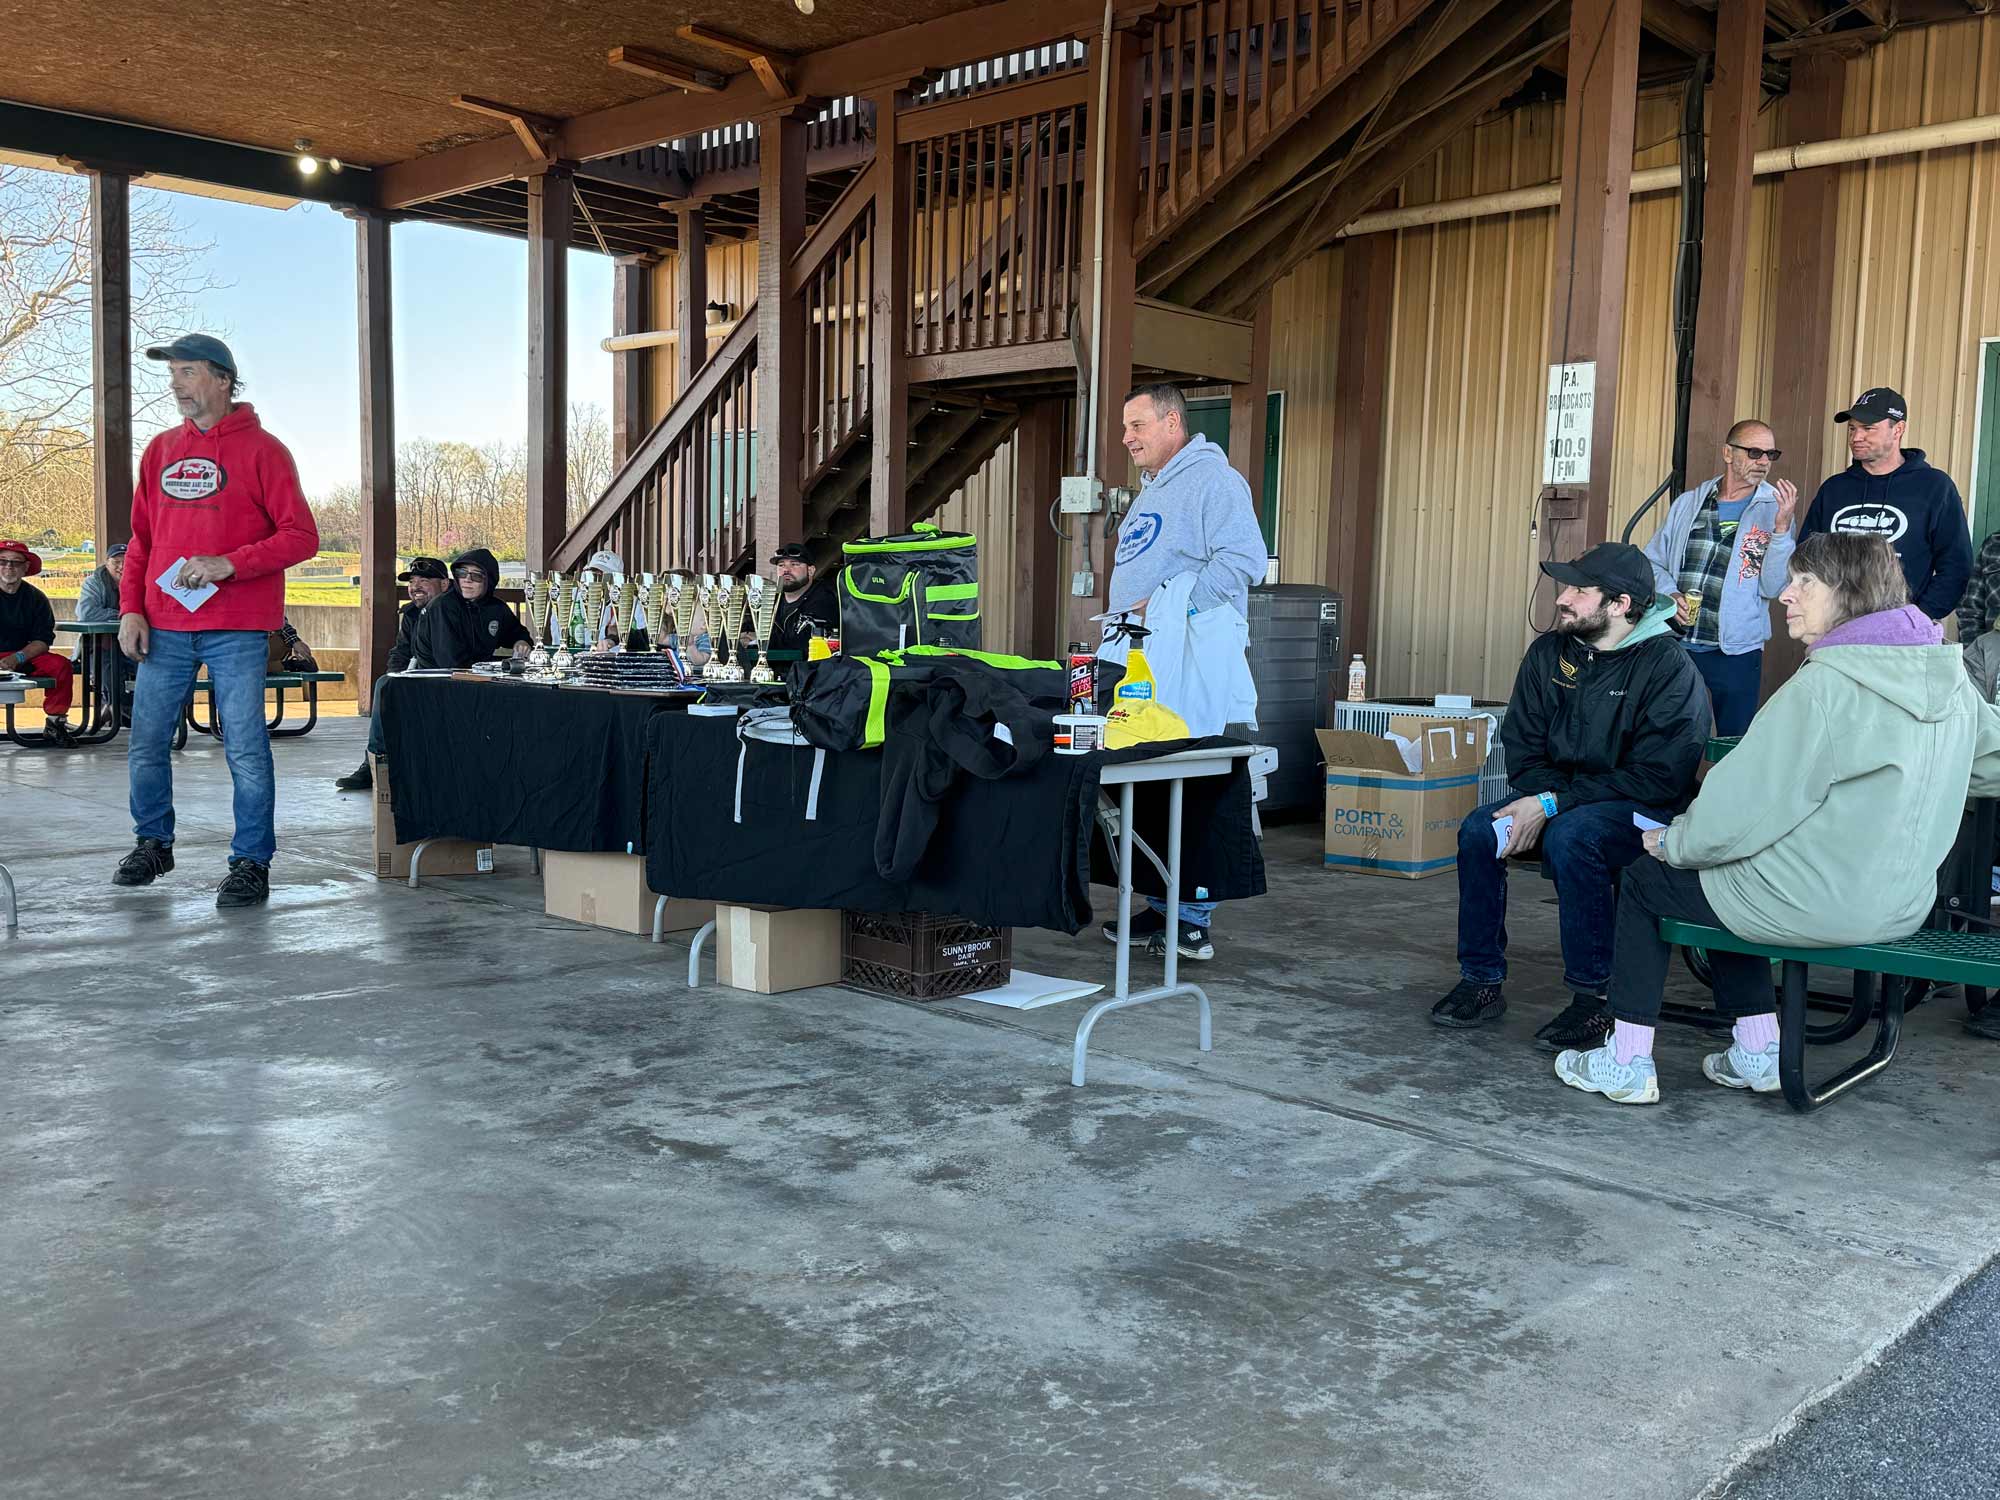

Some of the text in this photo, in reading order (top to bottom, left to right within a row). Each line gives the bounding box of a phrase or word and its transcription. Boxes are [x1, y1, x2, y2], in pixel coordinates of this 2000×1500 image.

[1563, 371, 1579, 387] P.A.
[1548, 392, 1592, 410] BROADCASTS
[1564, 413, 1575, 429] ON
[1549, 437, 1586, 458] 100.9
[1557, 460, 1576, 477] FM
[1335, 807, 1404, 828] PORT &
[1334, 823, 1403, 840] COMPANY
[942, 941, 992, 957] SUNNYBROOK
[957, 952, 976, 961] DAIRY
